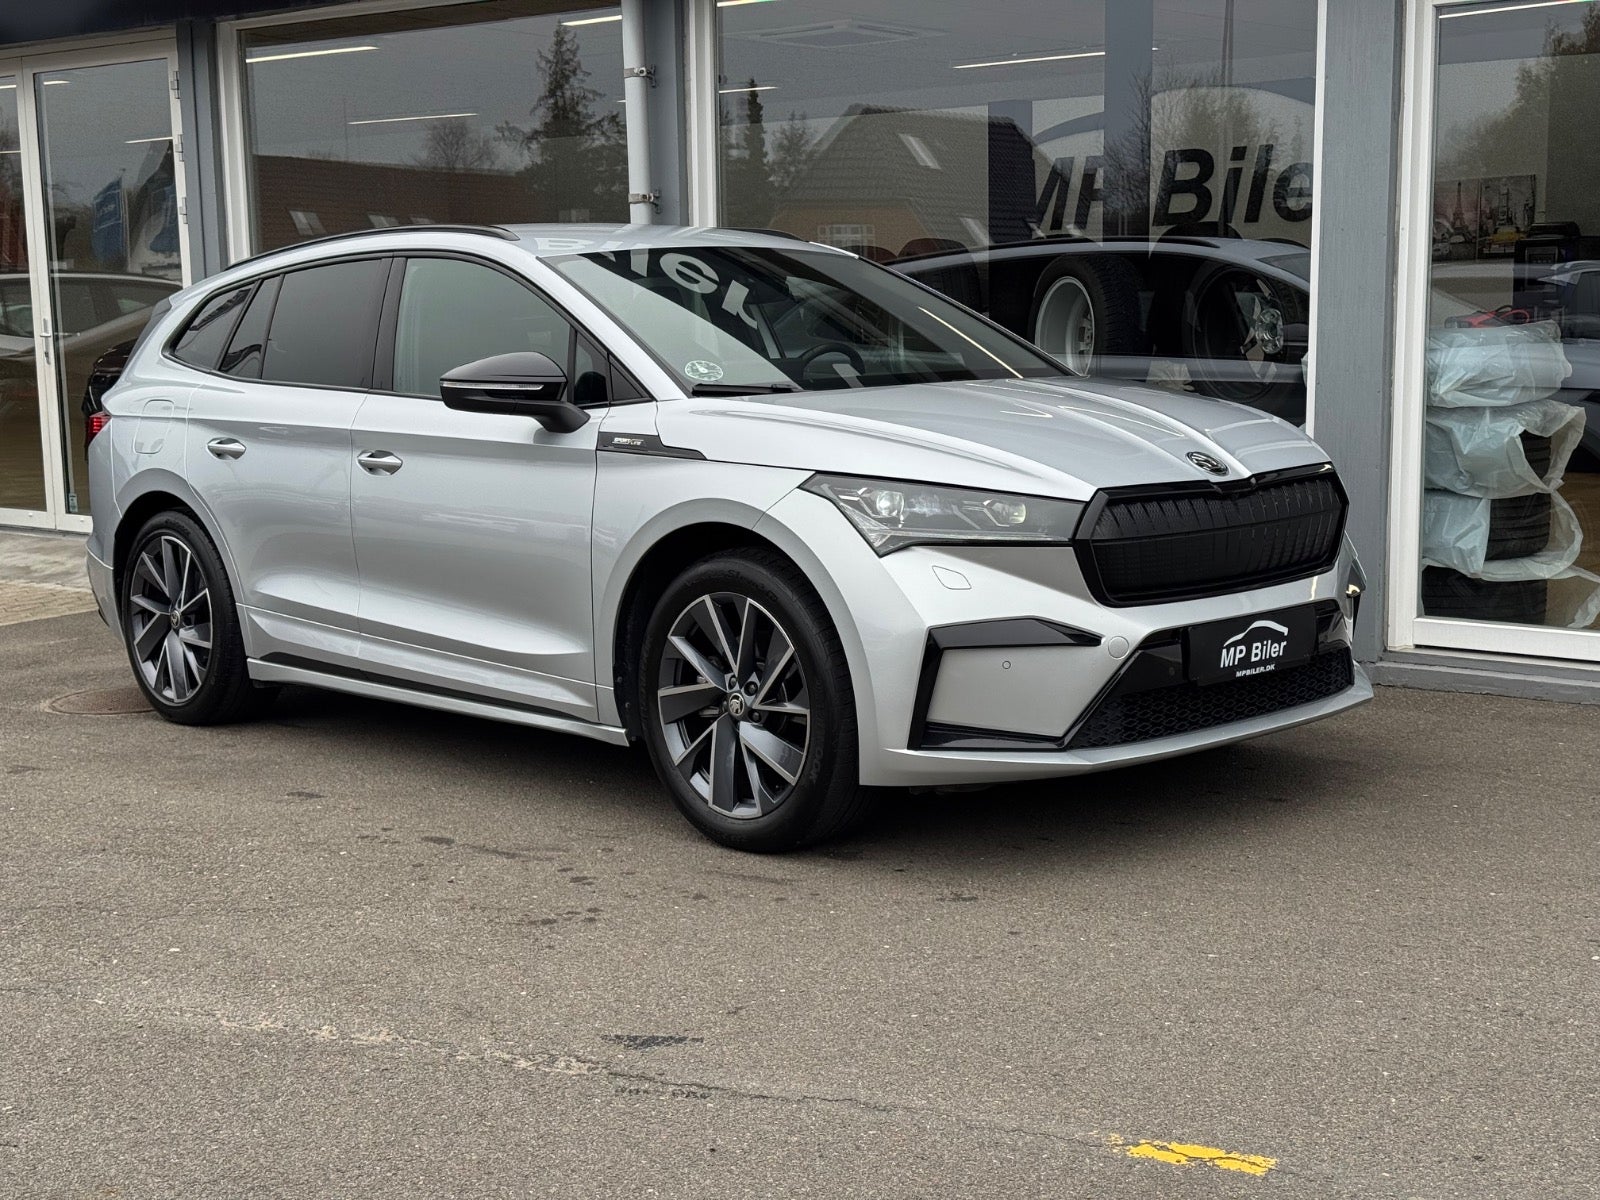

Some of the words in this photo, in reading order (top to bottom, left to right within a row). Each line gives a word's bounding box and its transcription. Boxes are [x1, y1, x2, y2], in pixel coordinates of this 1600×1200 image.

[1219, 645, 1247, 669] MP
[1250, 640, 1287, 663] Biler
[1235, 663, 1275, 678] MPBILER.DK
